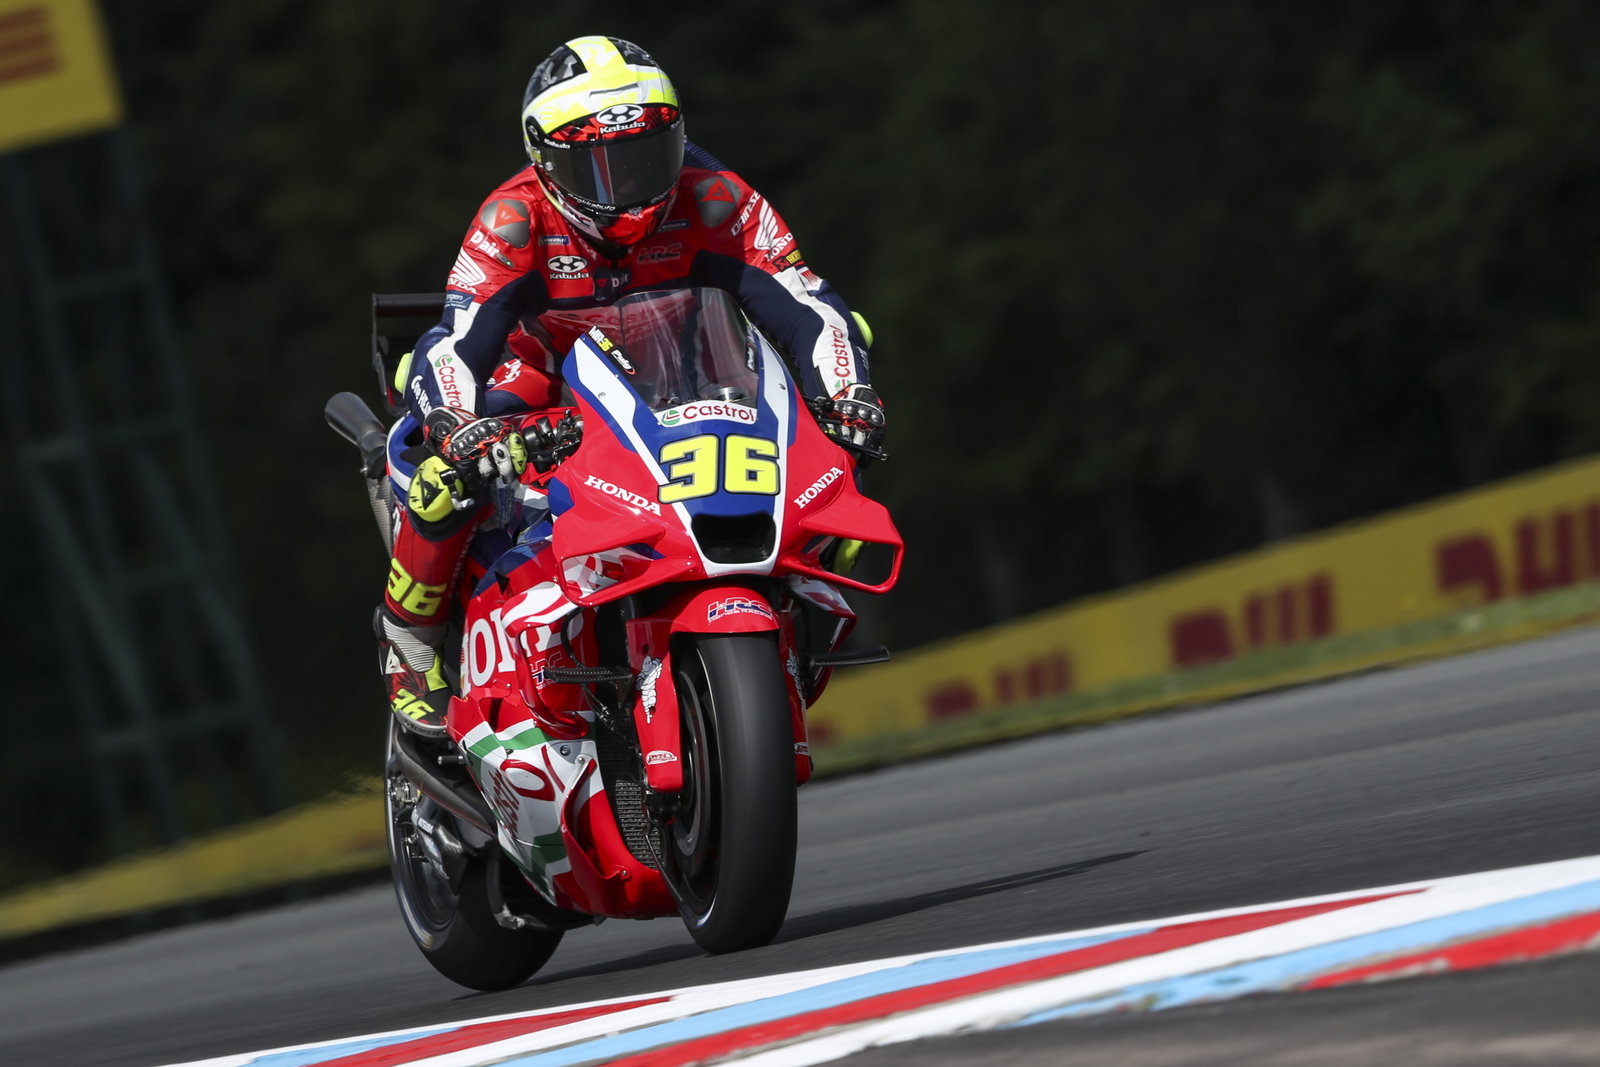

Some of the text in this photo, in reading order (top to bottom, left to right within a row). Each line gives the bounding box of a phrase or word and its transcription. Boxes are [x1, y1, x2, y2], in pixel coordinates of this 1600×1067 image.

[600, 121, 646, 135] Kabuto
[765, 232, 793, 262] HOND
[448, 277, 480, 295] NDA
[828, 324, 851, 378] Castrol
[438, 365, 463, 408] Castro
[682, 403, 756, 423] Castrol
[658, 433, 781, 504] 36
[583, 475, 662, 516] HONDA
[794, 466, 844, 509] HONDA
[387, 558, 448, 617] 36
[708, 597, 773, 620] HRC
[391, 688, 435, 721] 36
